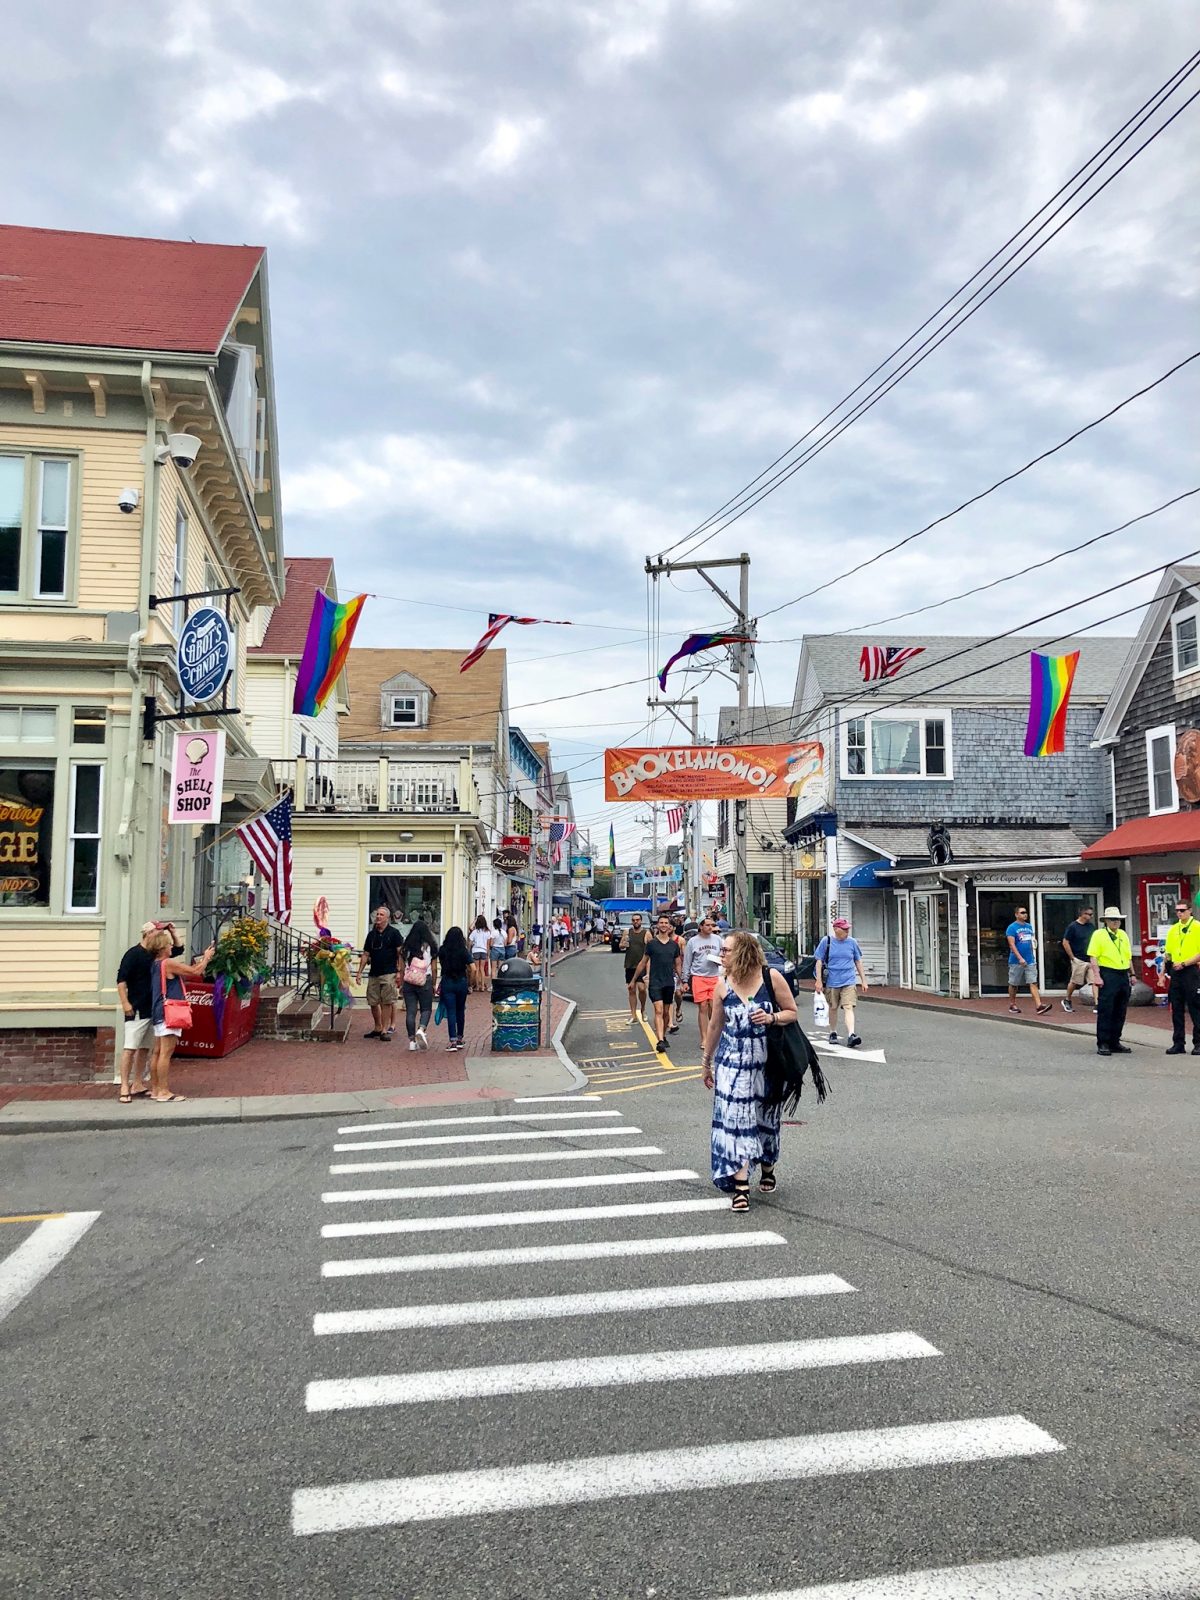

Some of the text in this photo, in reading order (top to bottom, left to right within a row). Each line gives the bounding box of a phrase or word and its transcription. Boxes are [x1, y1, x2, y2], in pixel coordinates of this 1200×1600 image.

[190, 647, 221, 685] CANDY
[189, 767, 201, 776] The
[610, 750, 778, 797] BROKELAHOMO!
[176, 778, 213, 796] SHELL
[176, 796, 211, 812] SHOP
[494, 852, 528, 867] Zinnia
[1000, 873, 1017, 883] Cape
[1020, 873, 1034, 882] Cod
[1035, 873, 1065, 884] Jewelry
[184, 991, 215, 1006] Coca-Col
